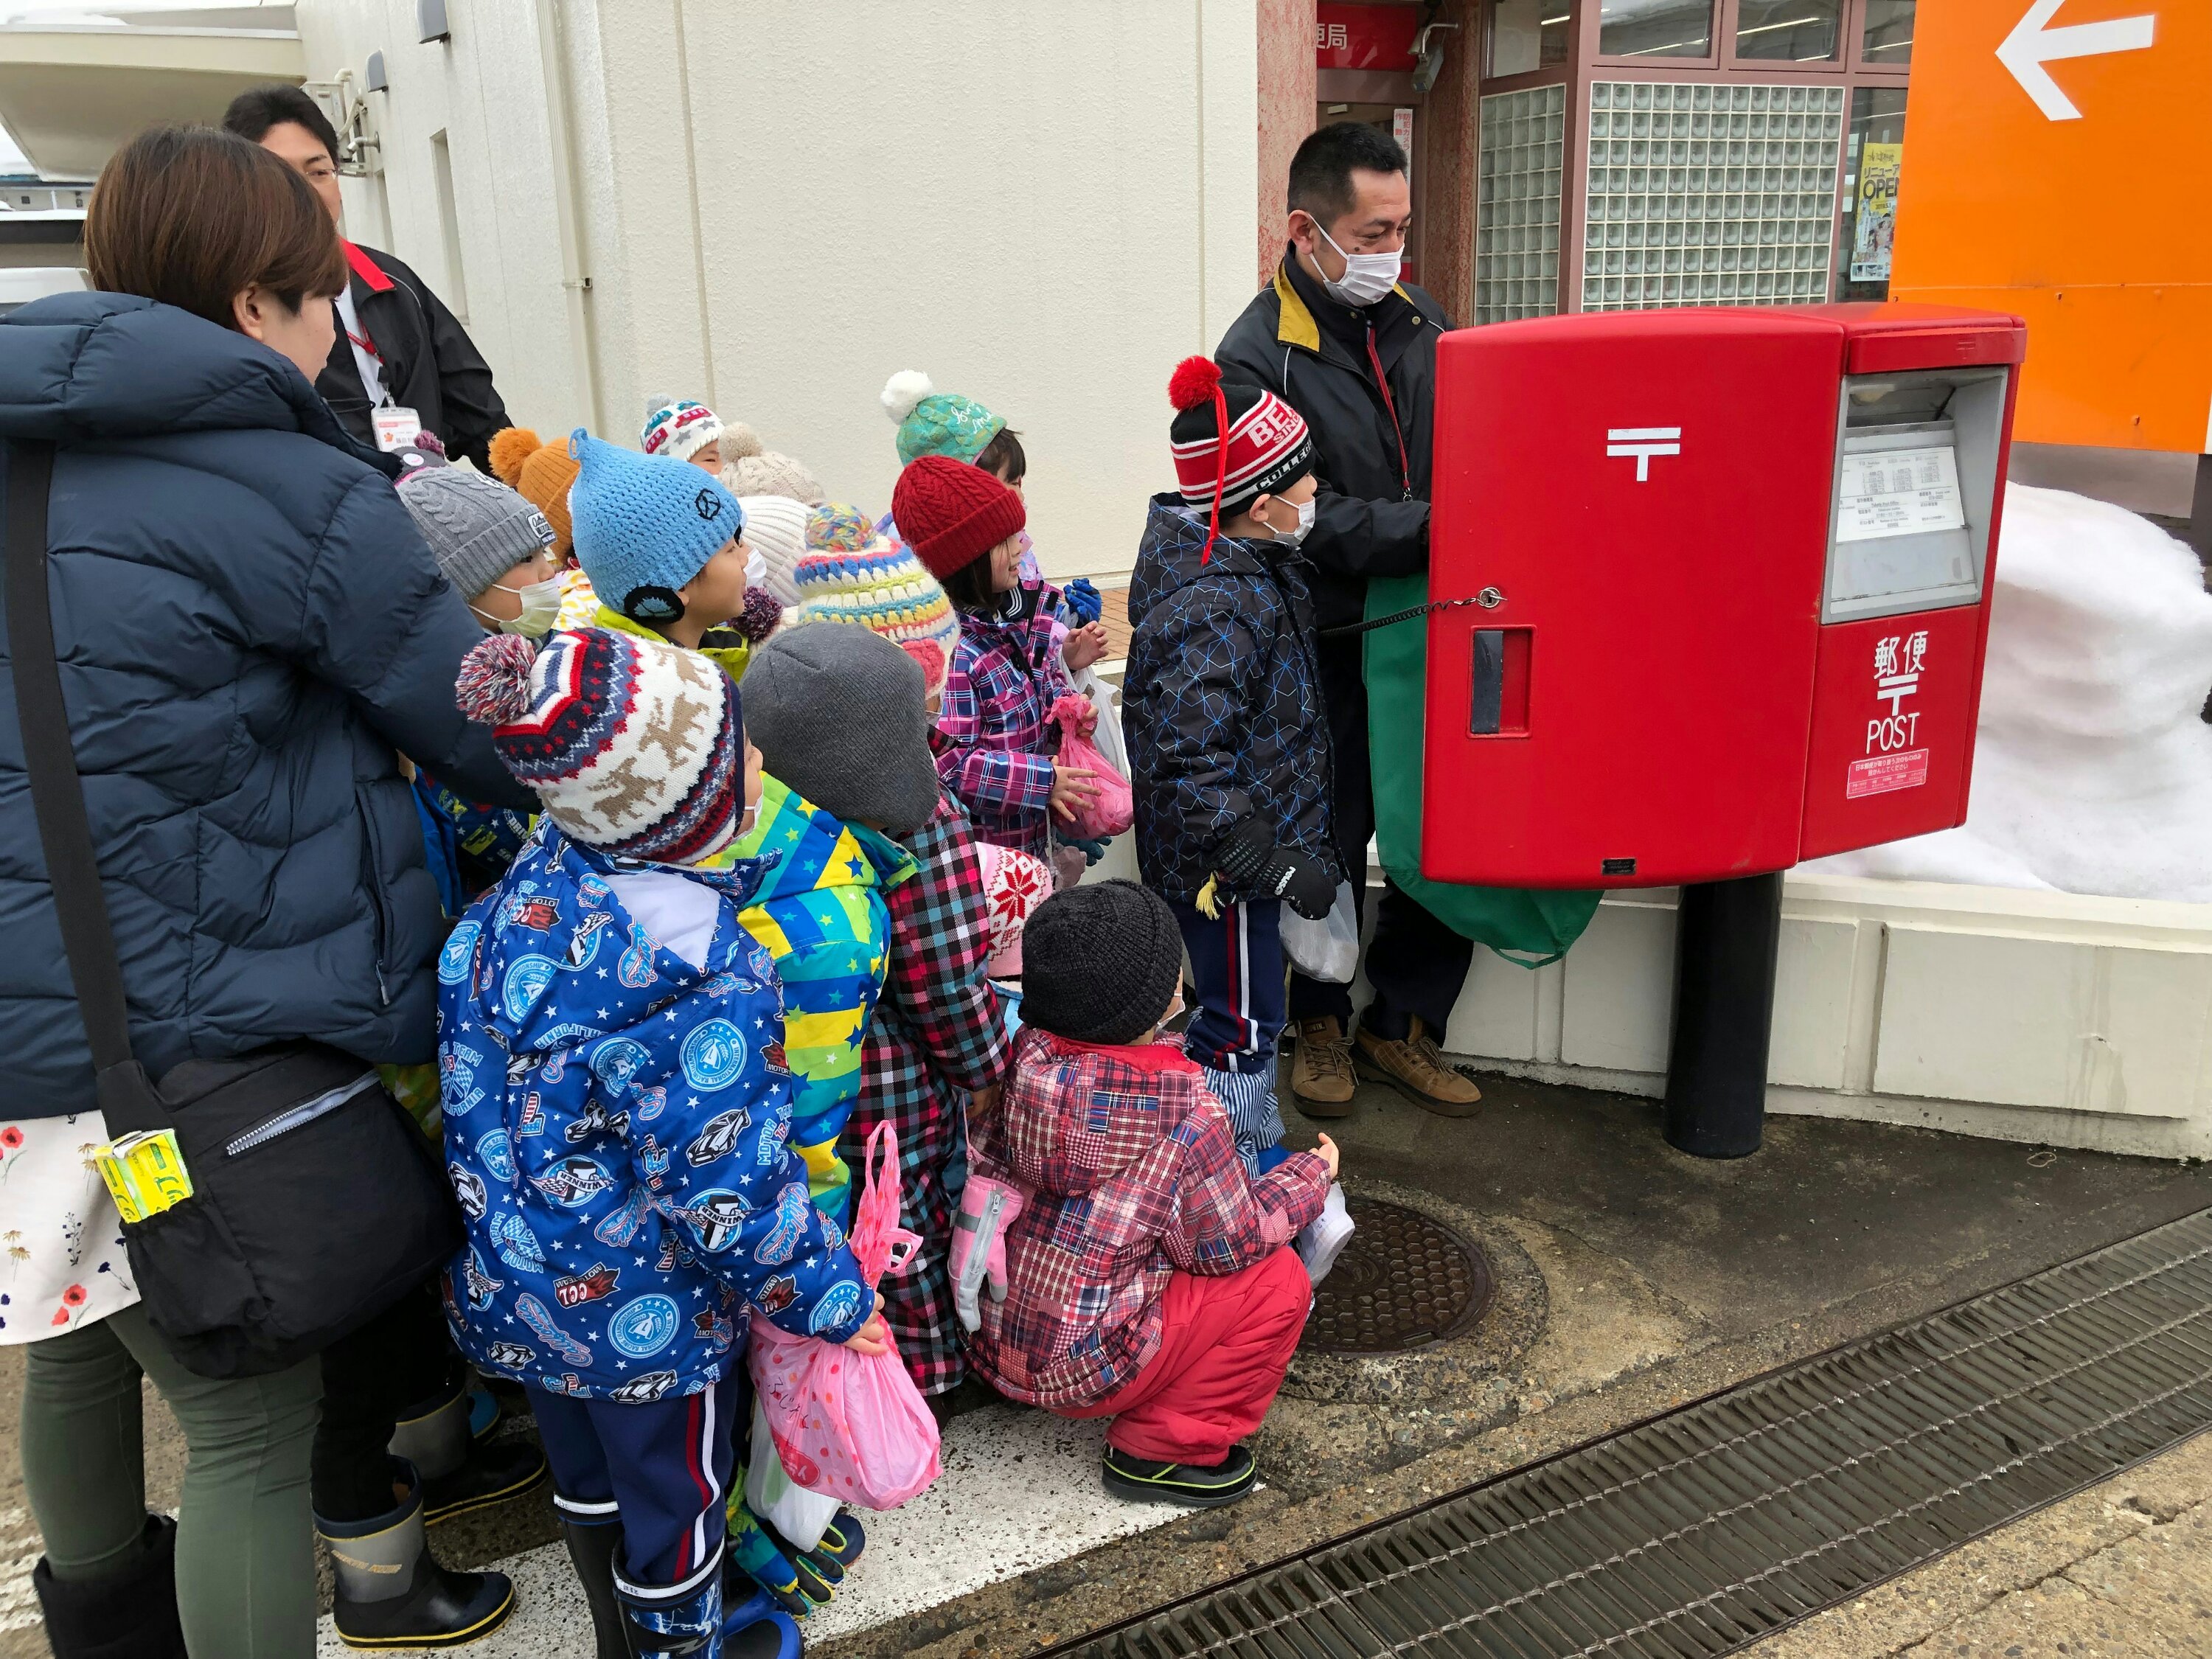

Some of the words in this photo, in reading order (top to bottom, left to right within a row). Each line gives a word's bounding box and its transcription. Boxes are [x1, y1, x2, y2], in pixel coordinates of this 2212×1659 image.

[1874, 630, 1928, 679] 郵便
[1865, 712, 1920, 754] POST
[453, 1041, 484, 1067] TEAM
[757, 1119, 777, 1166] MOTOR
[560, 1171, 605, 1190] WINNER
[701, 1206, 742, 1225] WINNER
[490, 1211, 507, 1248] TEAM
[501, 1249, 544, 1274] MOTOR
[559, 1284, 588, 1307] CCL
